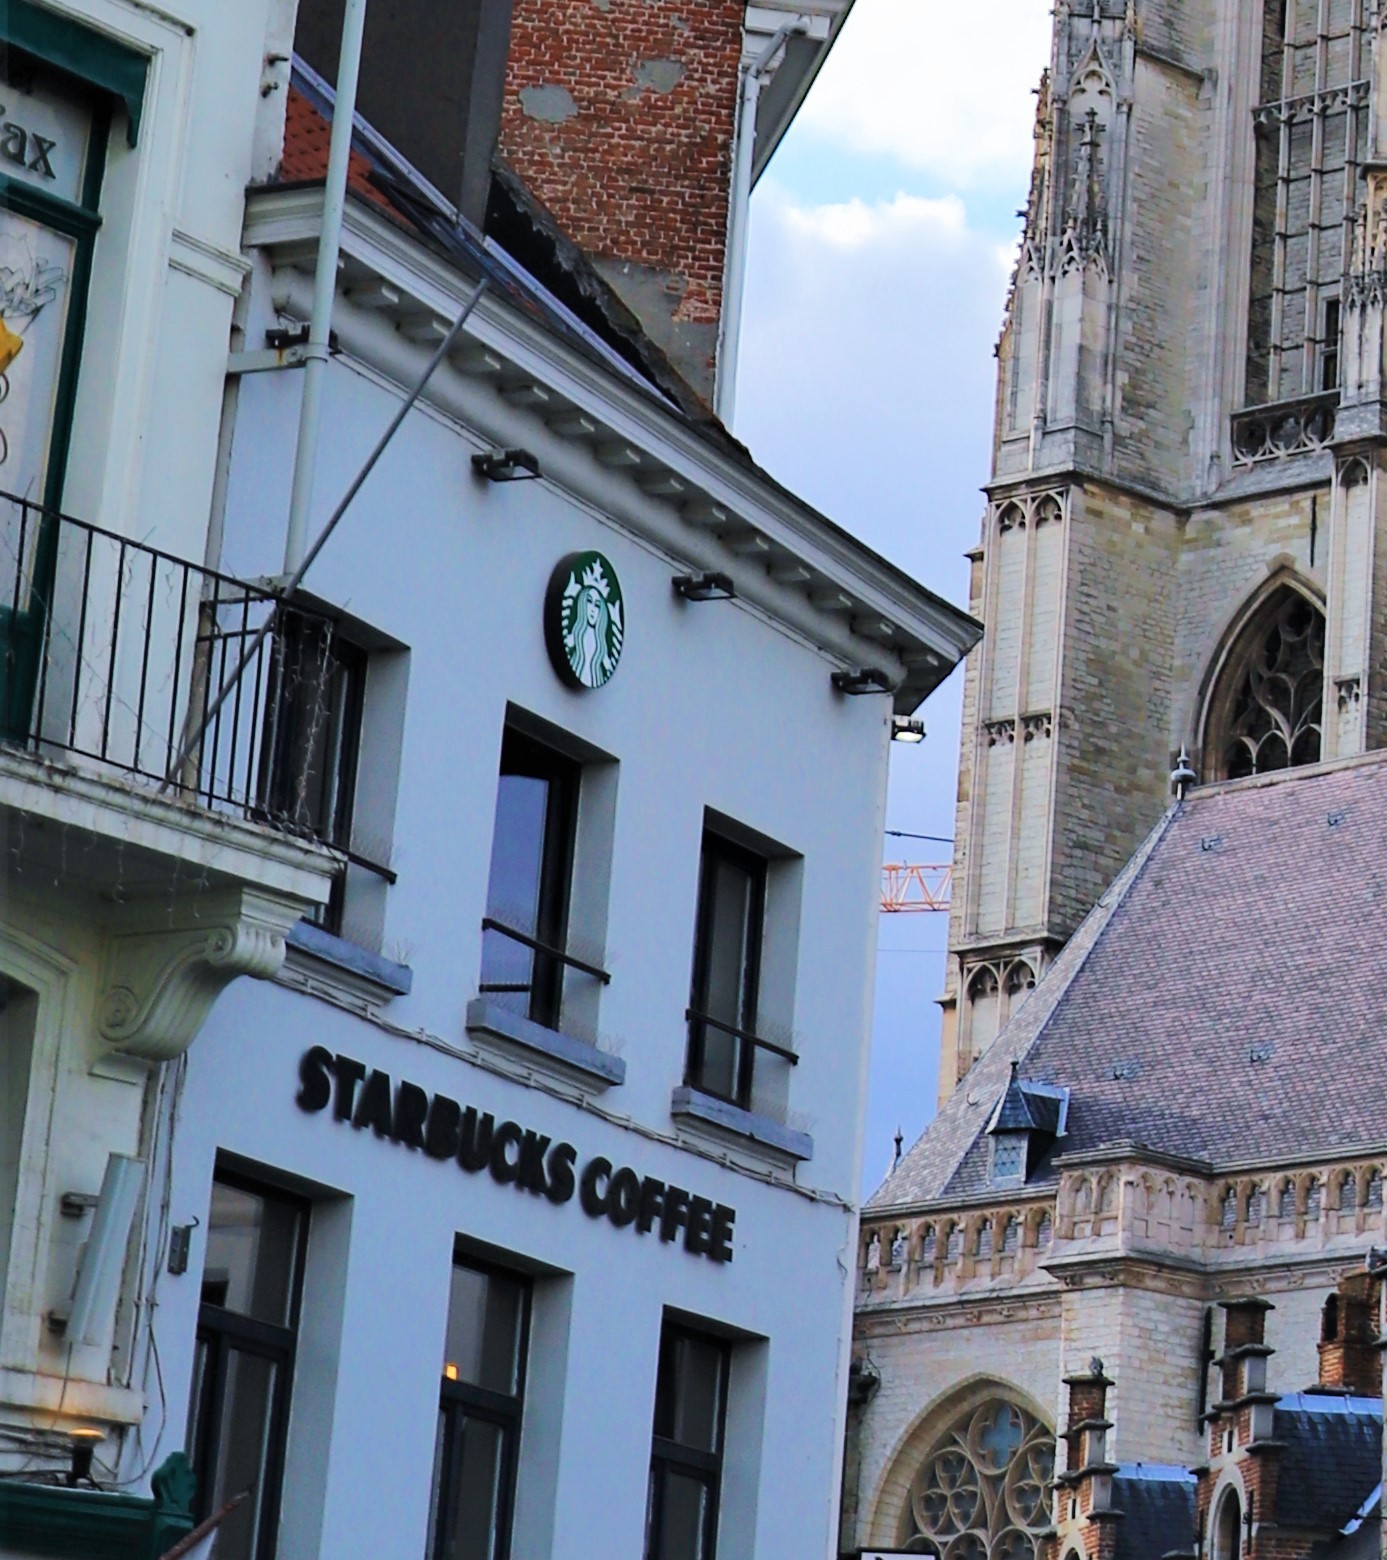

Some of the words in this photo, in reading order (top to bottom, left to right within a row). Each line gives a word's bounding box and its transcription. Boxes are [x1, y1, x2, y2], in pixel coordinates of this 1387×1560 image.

[0, 105, 57, 180] ax
[298, 1045, 577, 1205] STARBUCKS
[580, 1156, 737, 1263] COFFEE
